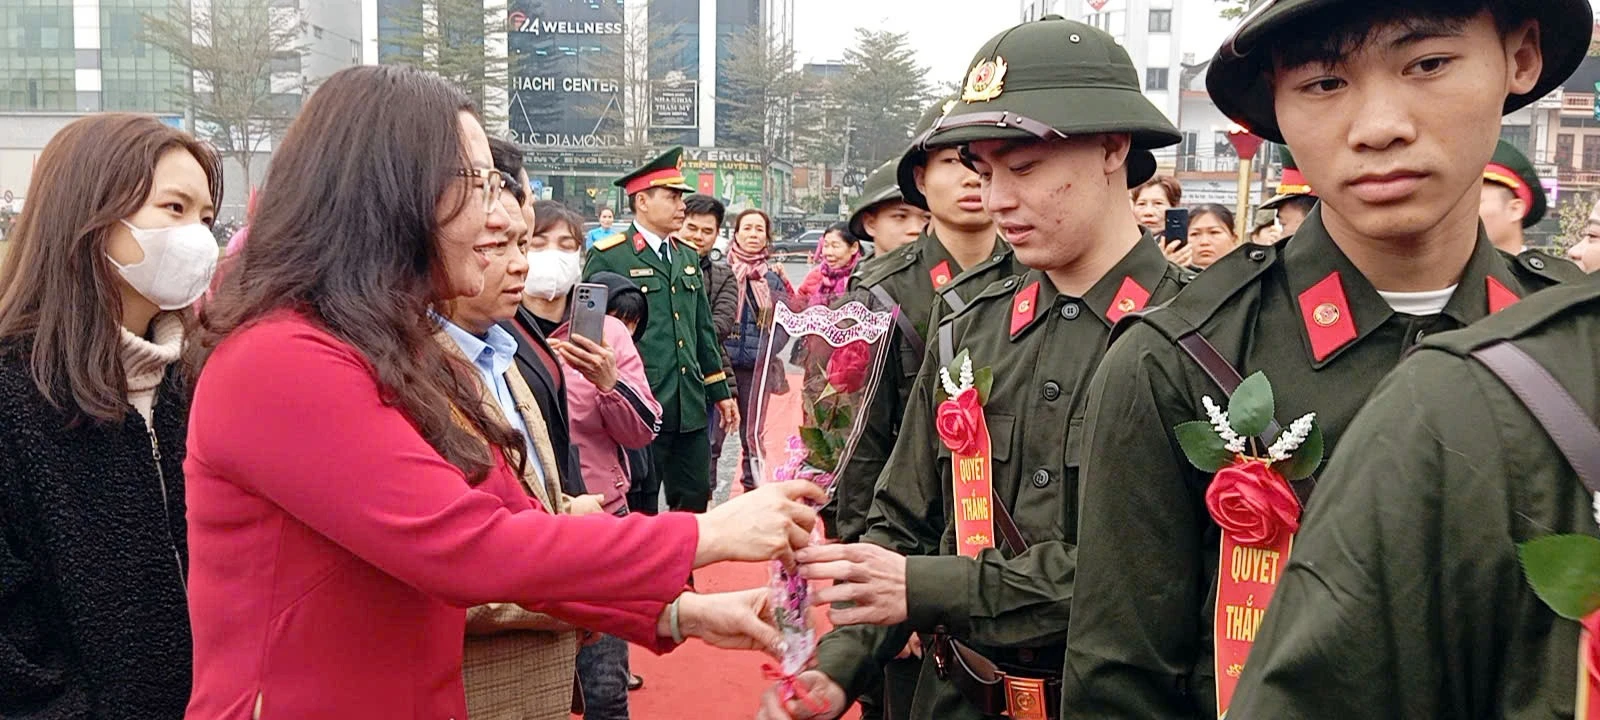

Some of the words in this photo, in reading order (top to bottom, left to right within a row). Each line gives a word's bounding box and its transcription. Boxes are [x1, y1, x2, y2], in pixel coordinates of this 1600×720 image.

[541, 22, 622, 34] WELLNESS
[513, 76, 555, 91] HACHI
[562, 78, 619, 92] CENTER
[546, 133, 618, 147] DIAMOND
[522, 155, 559, 164] RMY
[1226, 594, 1264, 642] THẮN
